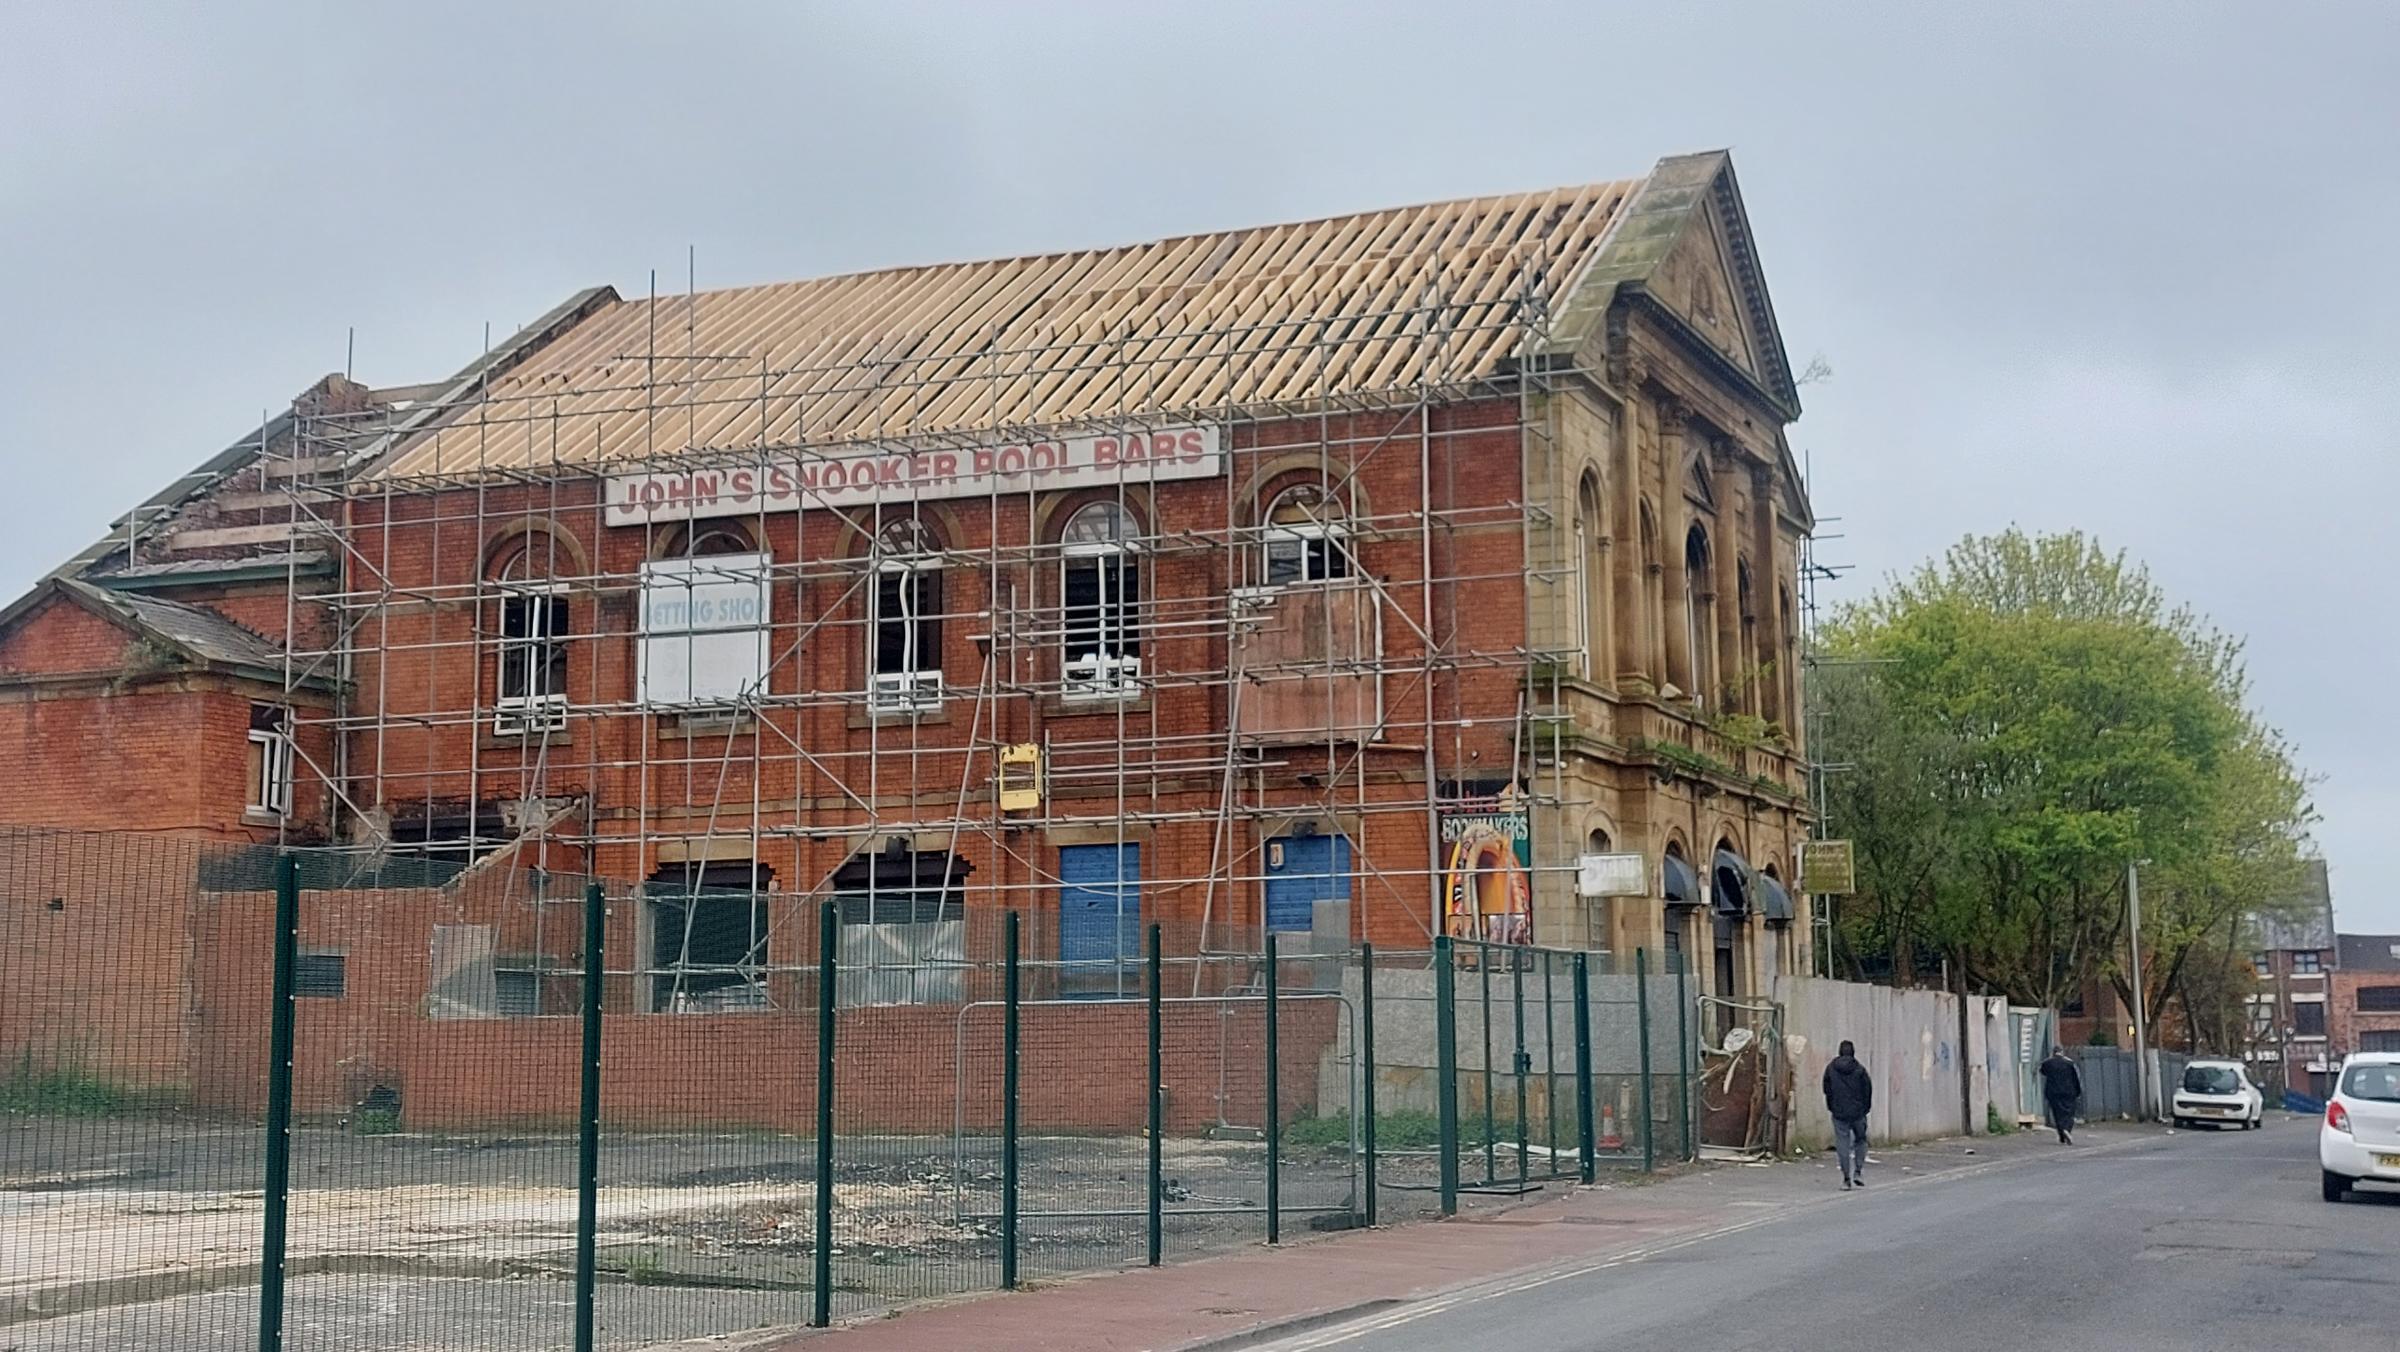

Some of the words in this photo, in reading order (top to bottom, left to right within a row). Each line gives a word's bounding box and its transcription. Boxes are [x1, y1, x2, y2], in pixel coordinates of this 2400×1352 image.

[617, 472, 754, 514] JOHN'S
[769, 453, 958, 499] SNOOKER
[973, 443, 1079, 483] POOL
[1094, 431, 1204, 472] BARS
[642, 599, 714, 626] BETTING
[718, 597, 766, 623] SHOP
